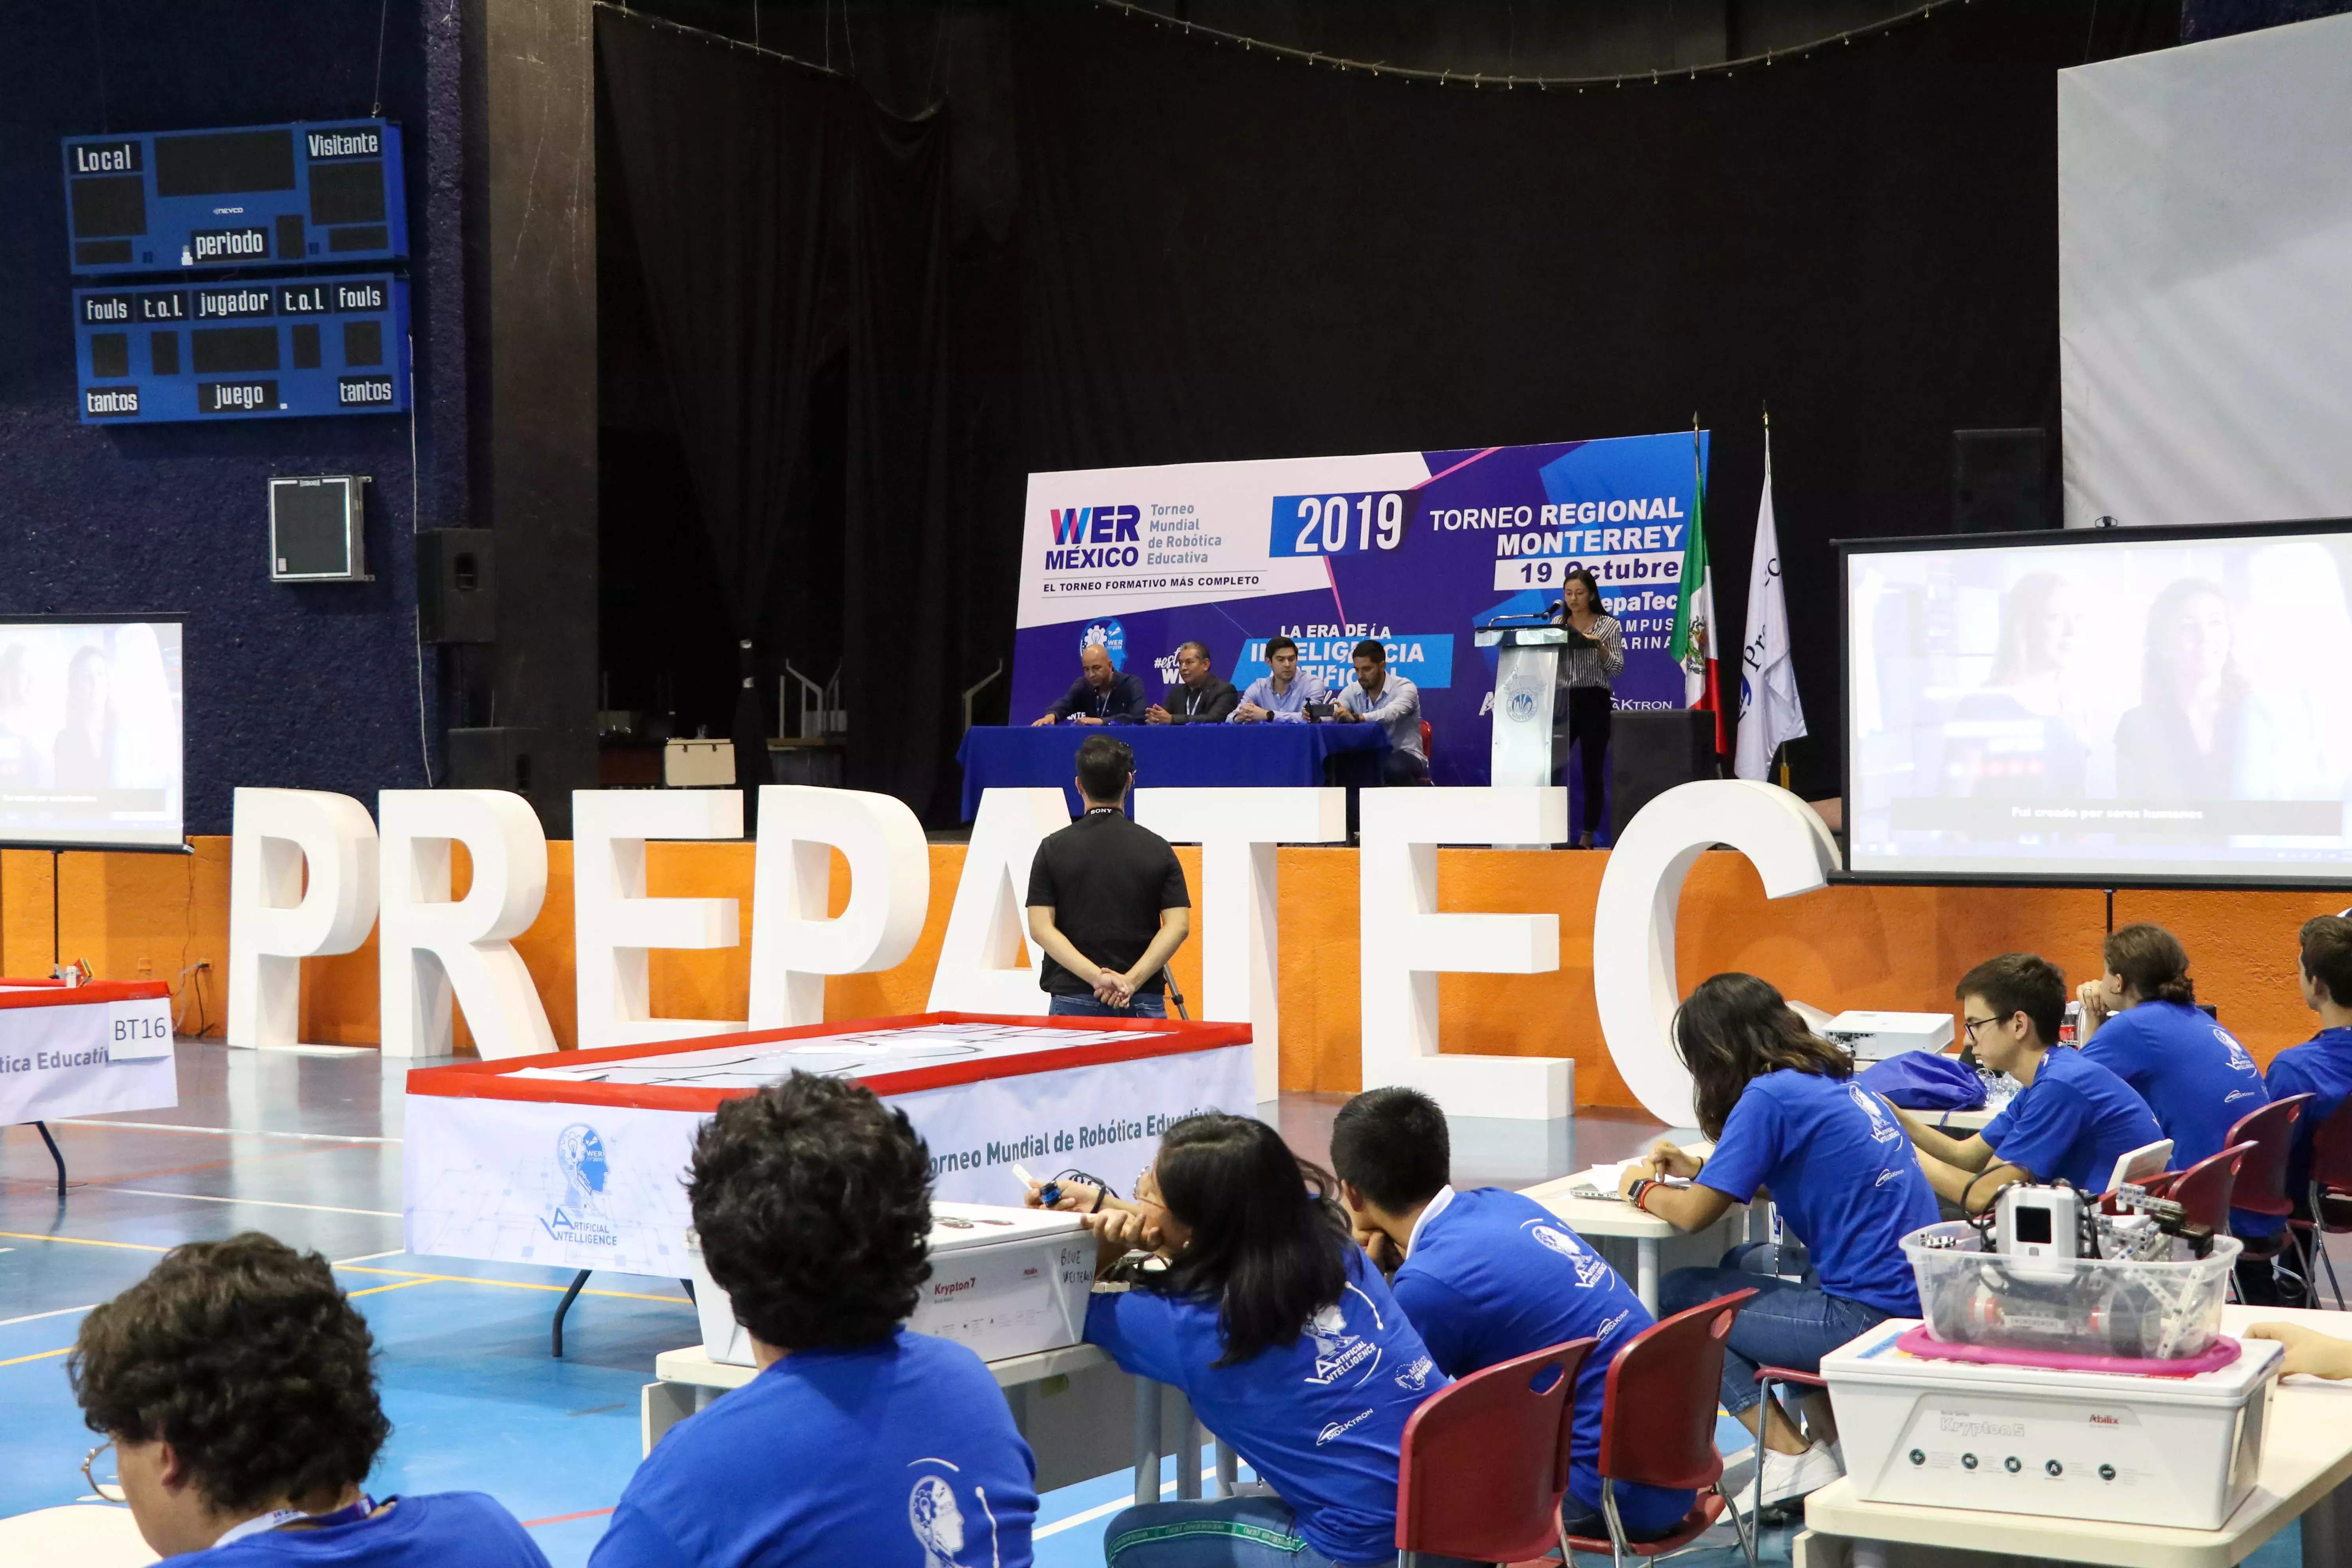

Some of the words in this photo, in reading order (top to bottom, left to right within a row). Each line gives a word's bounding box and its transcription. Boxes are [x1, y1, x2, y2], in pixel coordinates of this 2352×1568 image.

[308, 133, 378, 157] Visitante
[79, 145, 131, 171] Local
[196, 231, 263, 258] periodo
[200, 292, 268, 316] jugador
[340, 286, 381, 306] fouls
[87, 299, 127, 320] fouls
[87, 391, 138, 413] tantos
[215, 384, 263, 409] juego
[340, 379, 392, 402] tantos
[1151, 504, 1194, 516] Torneo
[1430, 506, 1532, 531] TORNEO
[1540, 497, 1683, 526] REGIONAL
[1051, 504, 1140, 545] WER
[1150, 519, 1200, 532] Mundial
[1295, 493, 1402, 553] 2019
[1148, 536, 1163, 549] de
[1166, 534, 1222, 548] Robótica
[1497, 525, 1683, 556] MONTERREY
[1045, 545, 1139, 570] MÉXICO
[1147, 552, 1208, 565] Educativa
[1043, 584, 1056, 593] EL
[1060, 582, 1102, 591] TORNEO
[1106, 580, 1167, 590] FORMATIVO
[1170, 576, 1194, 587] MÁS
[1198, 576, 1259, 586] COMPLETO
[1520, 563, 1552, 583] 19
[1601, 591, 1678, 616] epaTec
[1281, 625, 1301, 638] LA
[1307, 624, 1340, 638] ERA
[1345, 623, 1367, 636] DE
[1371, 624, 1392, 639] LA
[2012, 807, 2031, 817] Fui
[2035, 808, 2077, 818] creado
[2080, 809, 2103, 820] por
[115, 1017, 166, 1041] BT16
[38, 1047, 112, 1070] Educativ
[987, 1132, 1049, 1165] Mundial
[1055, 1130, 1074, 1152] de
[1080, 1119, 1141, 1149] Robótica
[553, 1208, 609, 1233] ARTIFICIAL
[1061, 1248, 1081, 1266] BLUE
[1305, 1342, 1377, 1384] INTELLIGENCE
[1316, 1340, 1367, 1378] ARTIFICIAL
[1326, 1408, 1373, 1441] DIDAKTRON
[2089, 1414, 2119, 1425] Abilix
